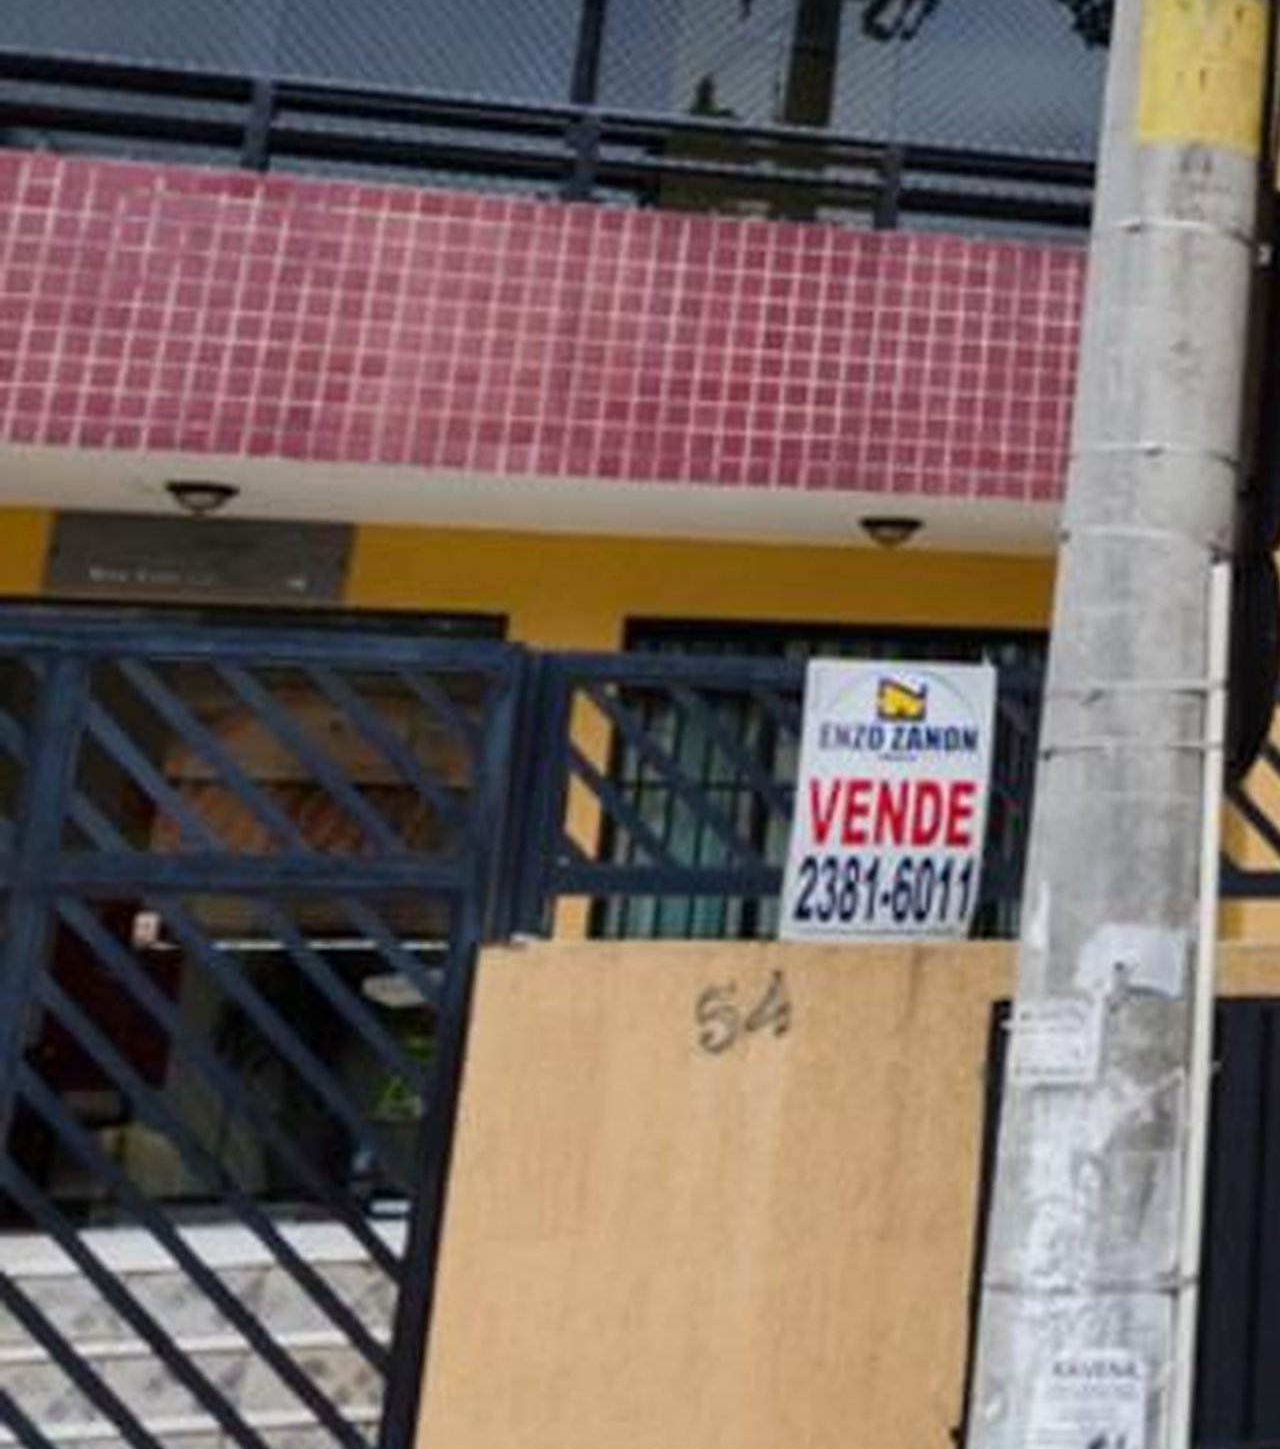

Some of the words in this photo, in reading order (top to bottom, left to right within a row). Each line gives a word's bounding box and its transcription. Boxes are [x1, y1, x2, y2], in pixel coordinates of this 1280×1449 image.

[818, 722, 885, 751] ENZO
[891, 724, 979, 752] ZANON
[809, 777, 977, 846] VENDE
[794, 856, 973, 922] 2381-6011
[694, 969, 791, 1056] 54
